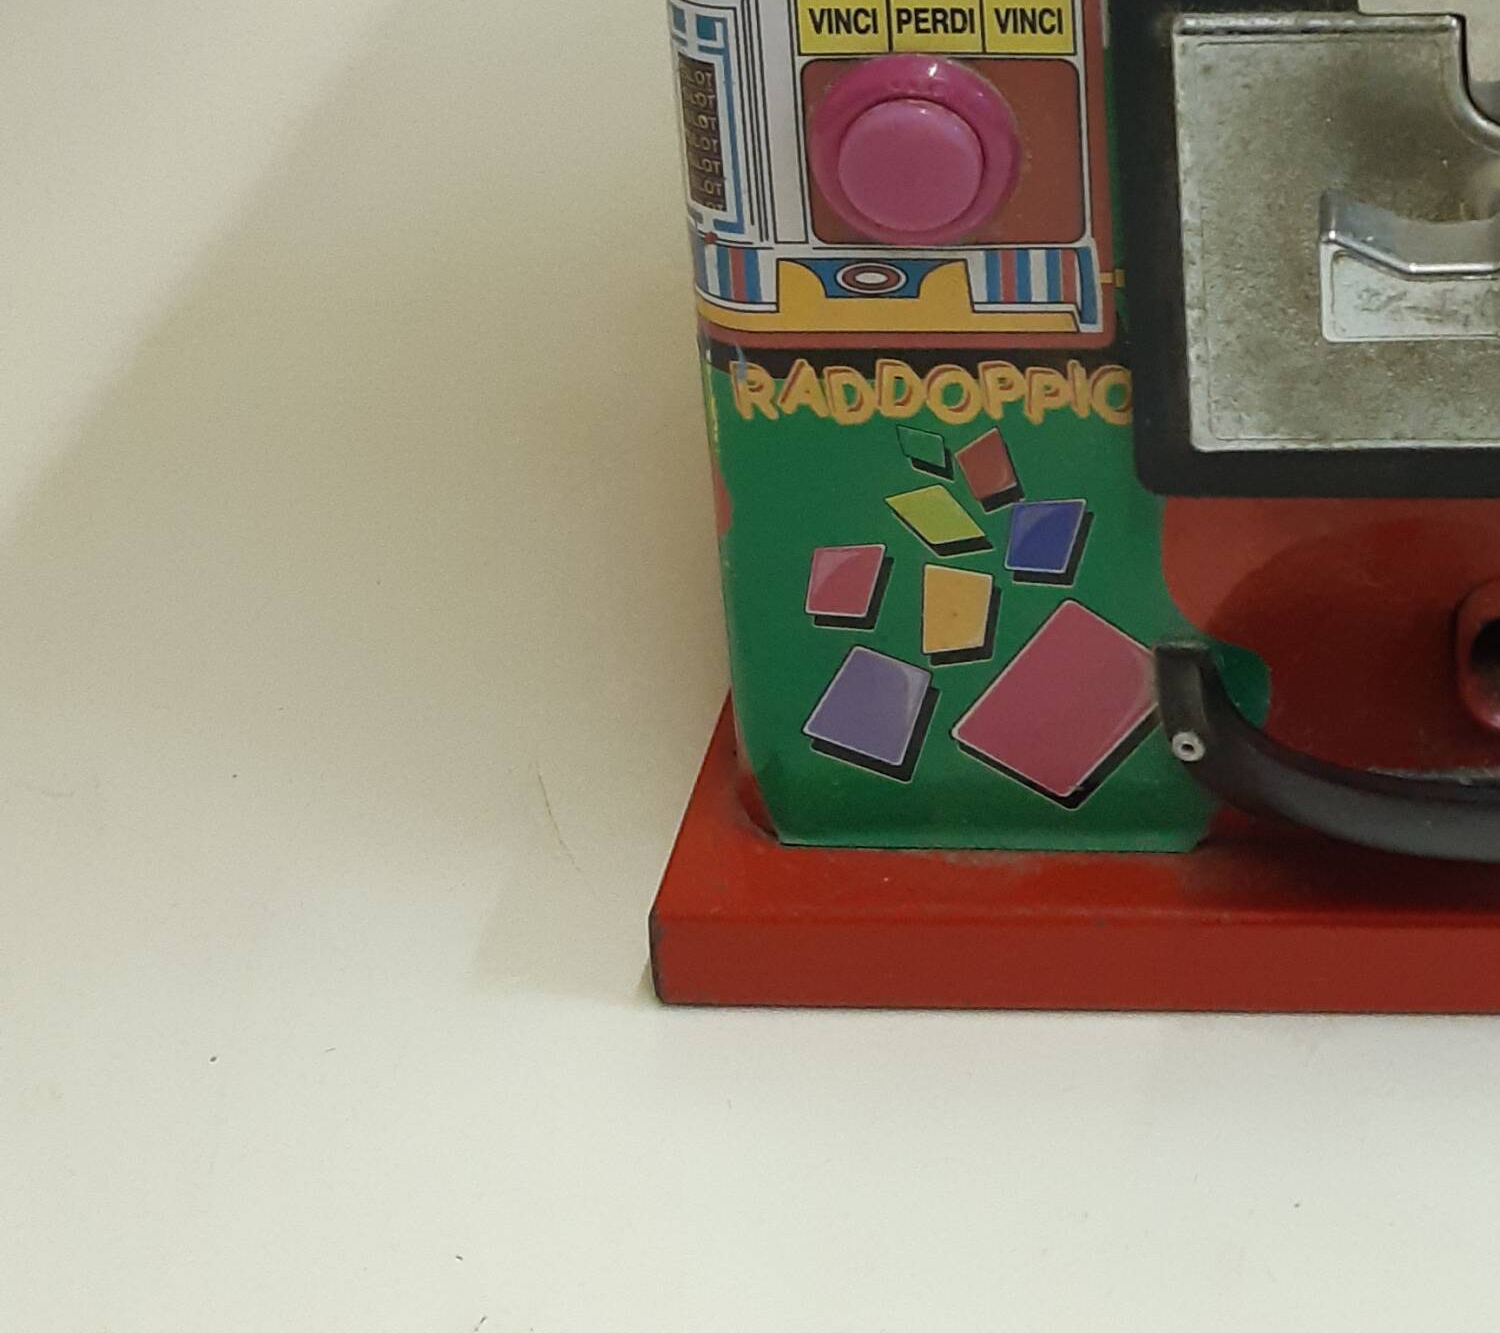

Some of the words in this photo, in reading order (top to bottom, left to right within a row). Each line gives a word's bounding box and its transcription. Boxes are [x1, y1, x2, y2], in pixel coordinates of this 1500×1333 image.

[808, 8, 879, 35] VINCI
[896, 7, 976, 35] PERDI
[994, 7, 1064, 35] VINCI
[730, 358, 1133, 426] RADDOPPIO
